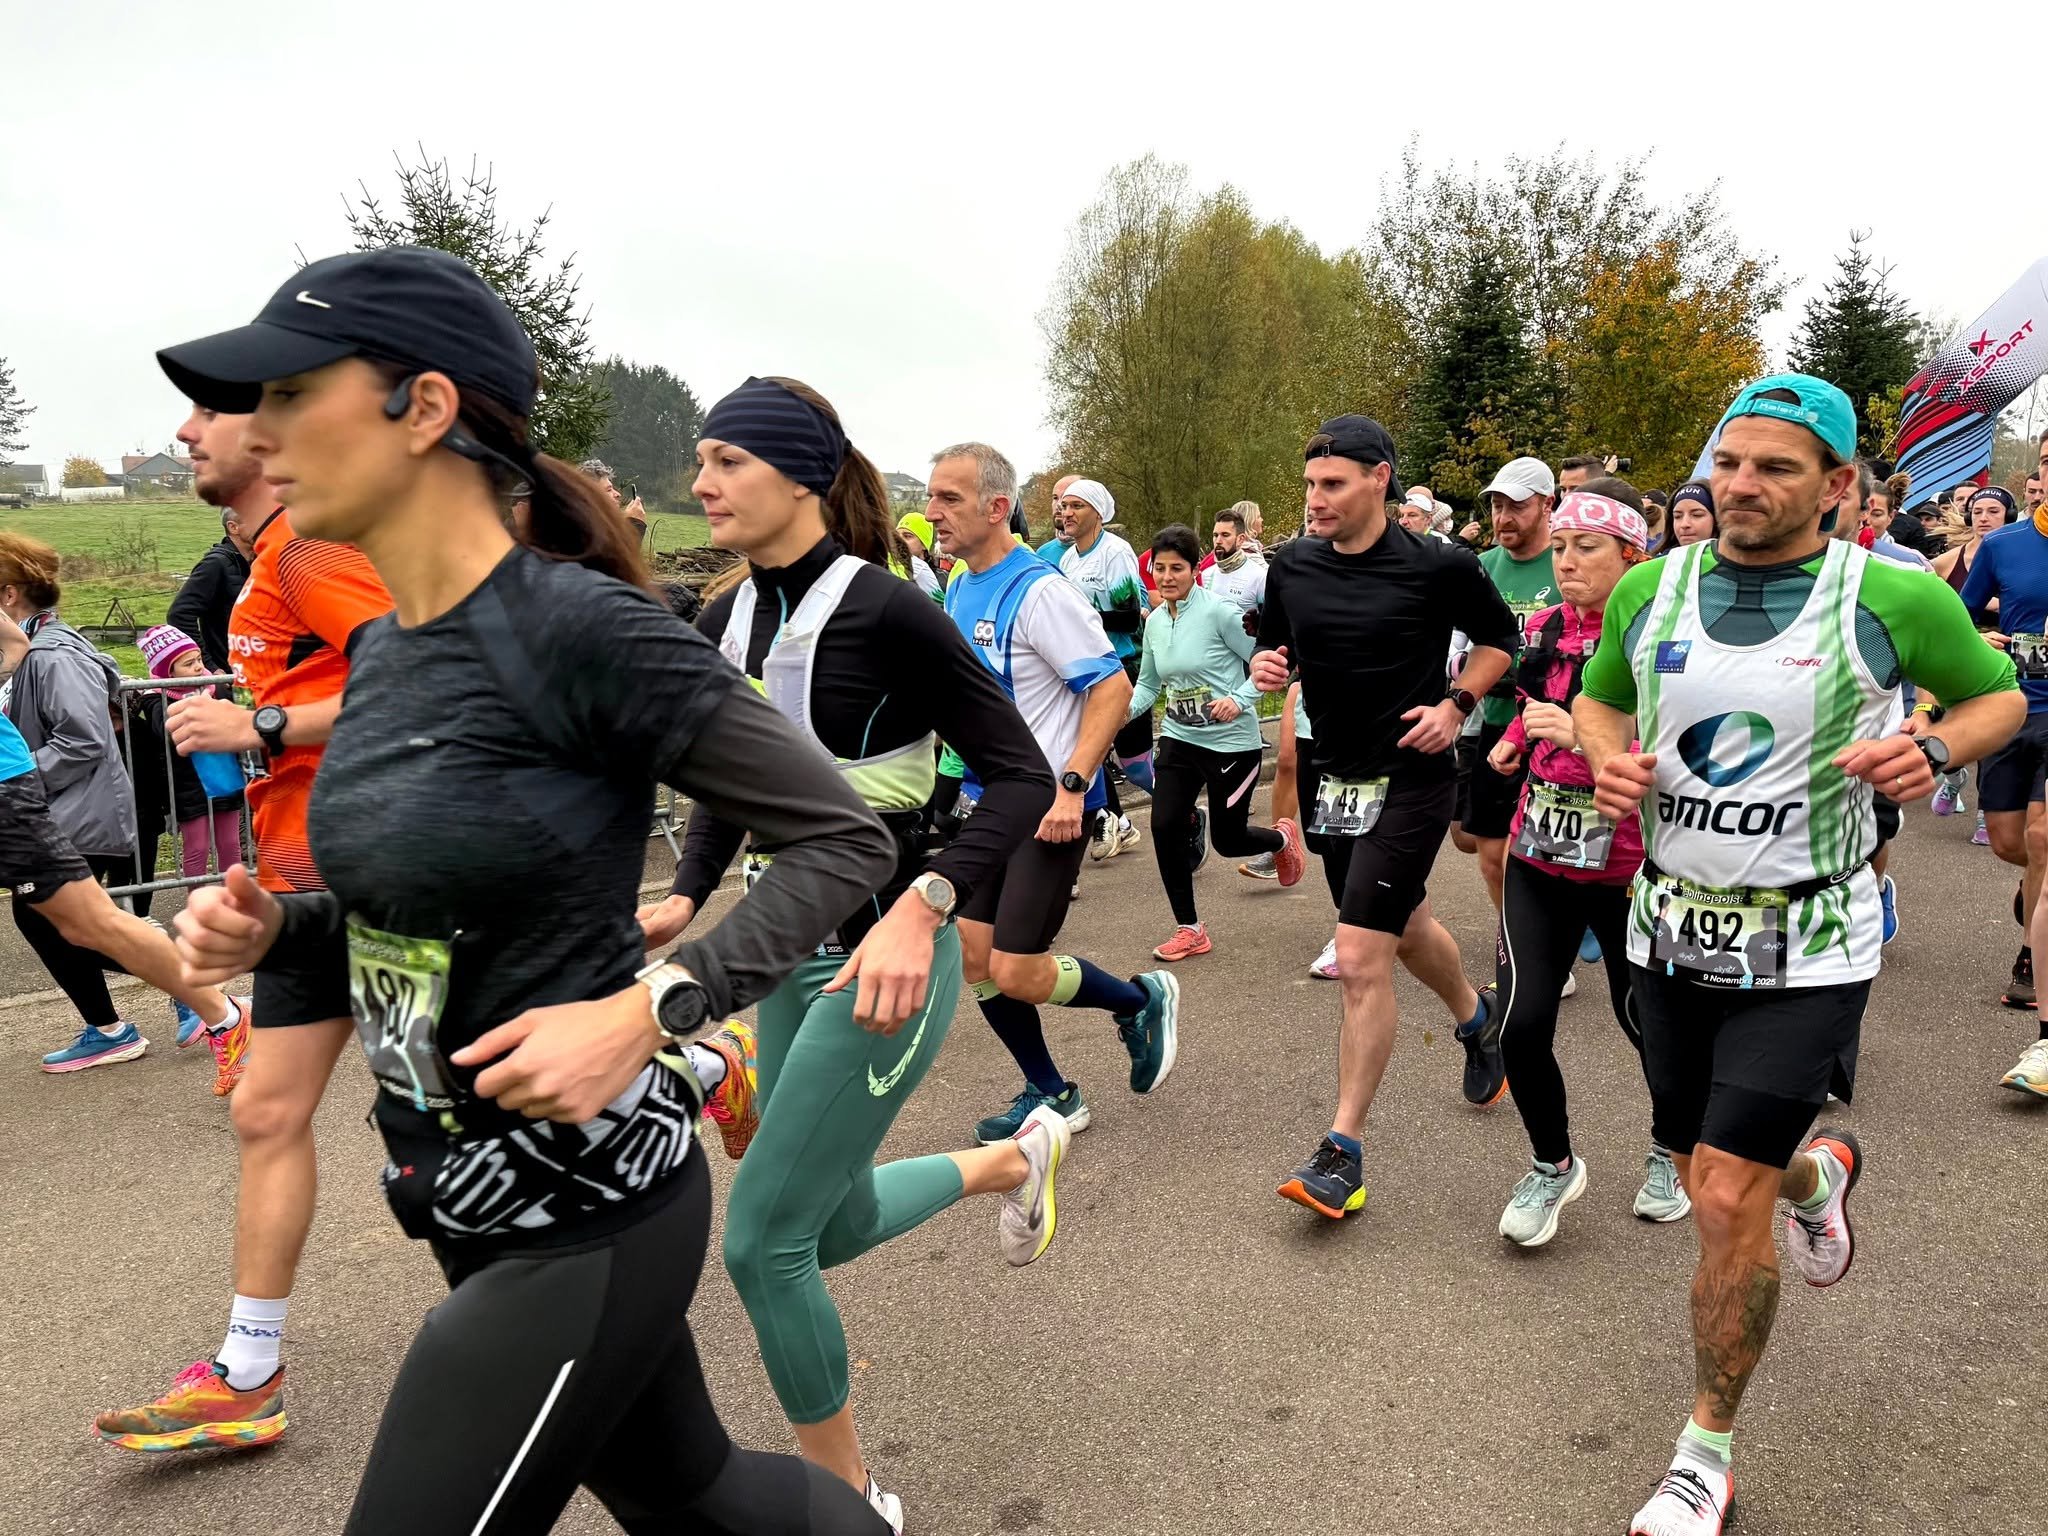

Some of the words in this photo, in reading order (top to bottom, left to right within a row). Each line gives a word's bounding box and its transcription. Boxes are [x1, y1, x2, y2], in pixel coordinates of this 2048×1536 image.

[1954, 318, 2034, 396] XSPORT
[972, 638, 993, 646] SPORT
[974, 620, 995, 640] GO
[1337, 787, 1359, 814] 43
[1658, 791, 1804, 837] amcor
[1539, 806, 1582, 841] 470
[1680, 907, 1744, 953] 492
[1703, 973, 1709, 981] 9
[1710, 975, 1753, 985] Novembre
[1755, 977, 1777, 986] 2025
